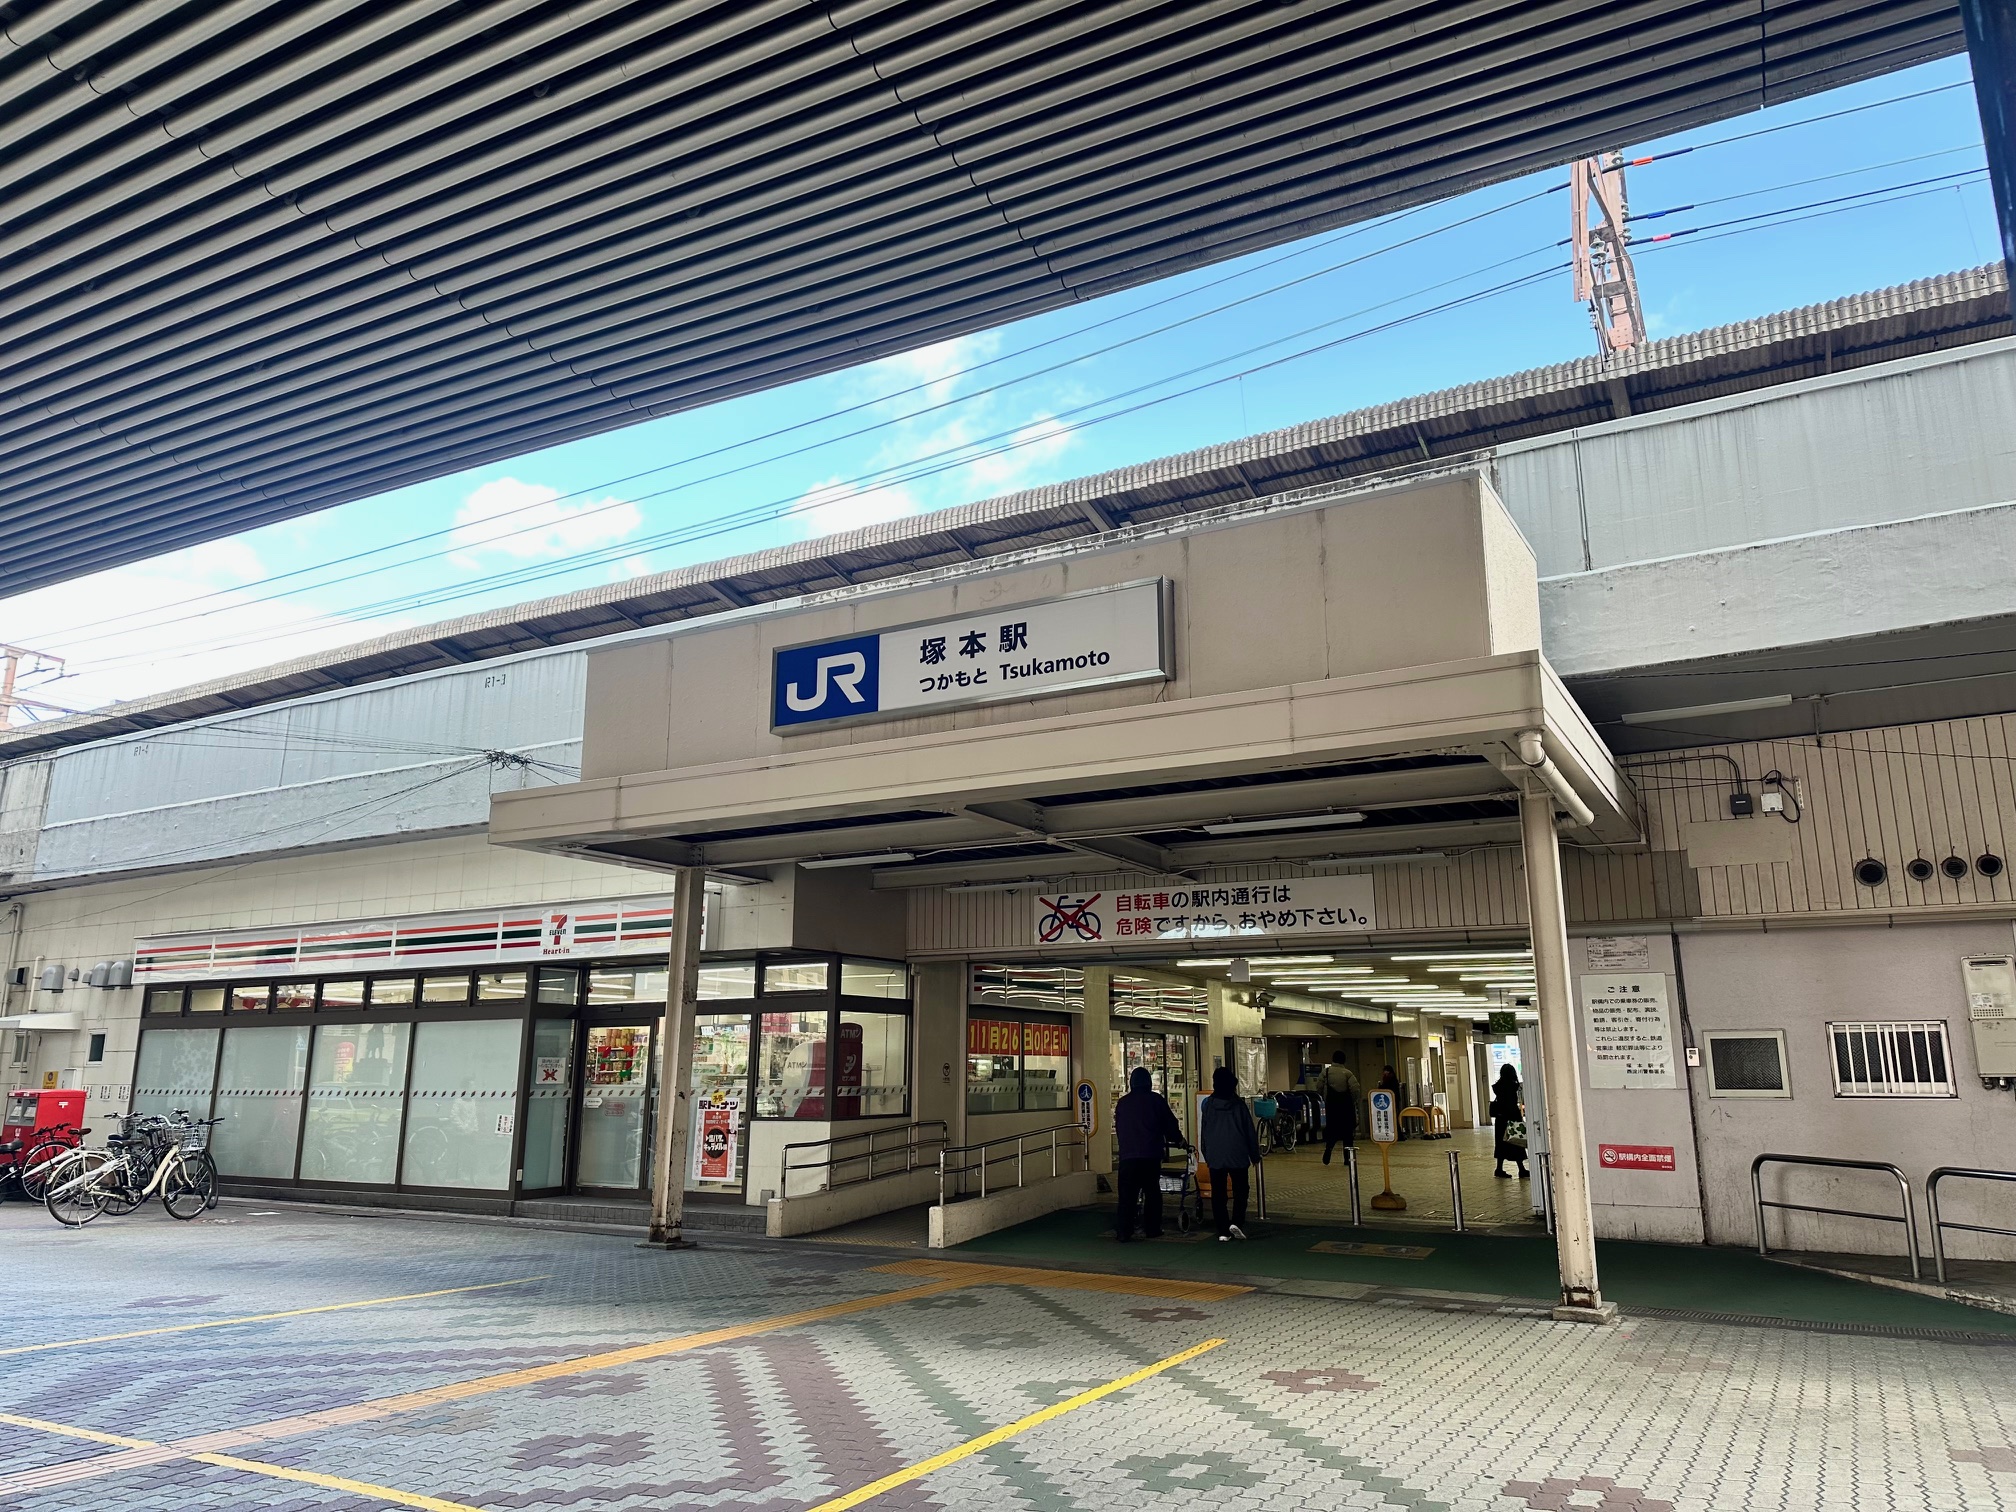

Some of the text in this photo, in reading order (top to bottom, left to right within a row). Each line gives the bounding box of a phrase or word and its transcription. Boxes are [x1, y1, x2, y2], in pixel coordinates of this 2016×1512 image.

[919, 621, 1028, 666] 塚本駅
[786, 651, 866, 712] JR
[919, 649, 1111, 693] つかもと Tsukamoto
[1115, 884, 1292, 913] 自転車の駅内通行は
[1115, 907, 1369, 936] 危険ですから、おやめ下さい。
[1607, 985, 1641, 994] ご注意
[840, 1029, 856, 1039] ATM
